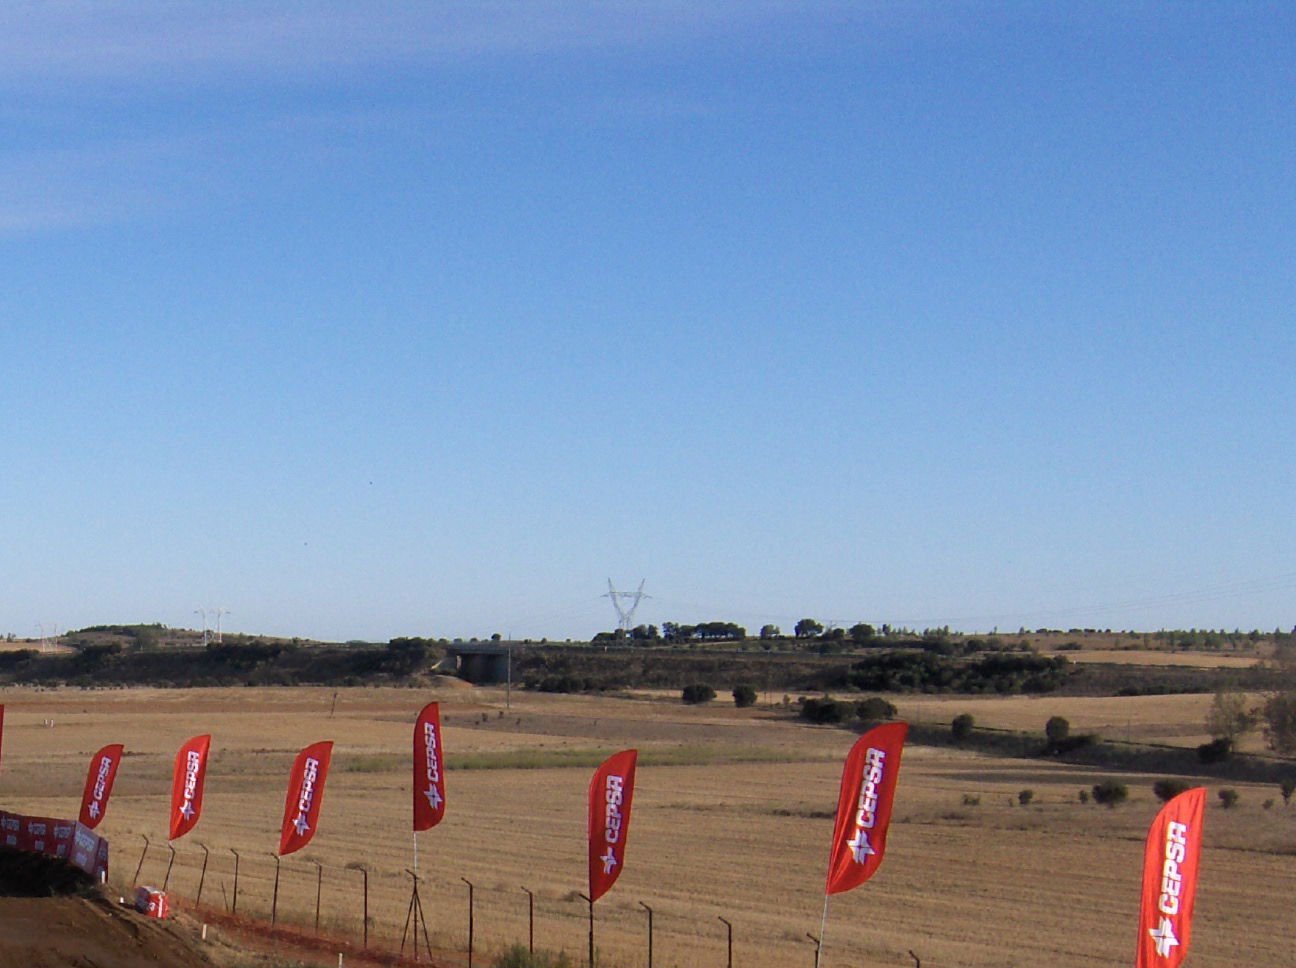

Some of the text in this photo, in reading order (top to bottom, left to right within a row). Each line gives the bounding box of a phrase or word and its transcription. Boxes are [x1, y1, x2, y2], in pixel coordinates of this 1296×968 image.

[93, 756, 112, 800] CEPSA
[184, 751, 200, 799] CEPSA
[424, 722, 439, 783] CEPSA
[299, 757, 319, 812] CEPSA
[605, 775, 624, 843] CEPSA
[856, 747, 886, 828] CEPSA
[1158, 821, 1187, 915] CEPSA
